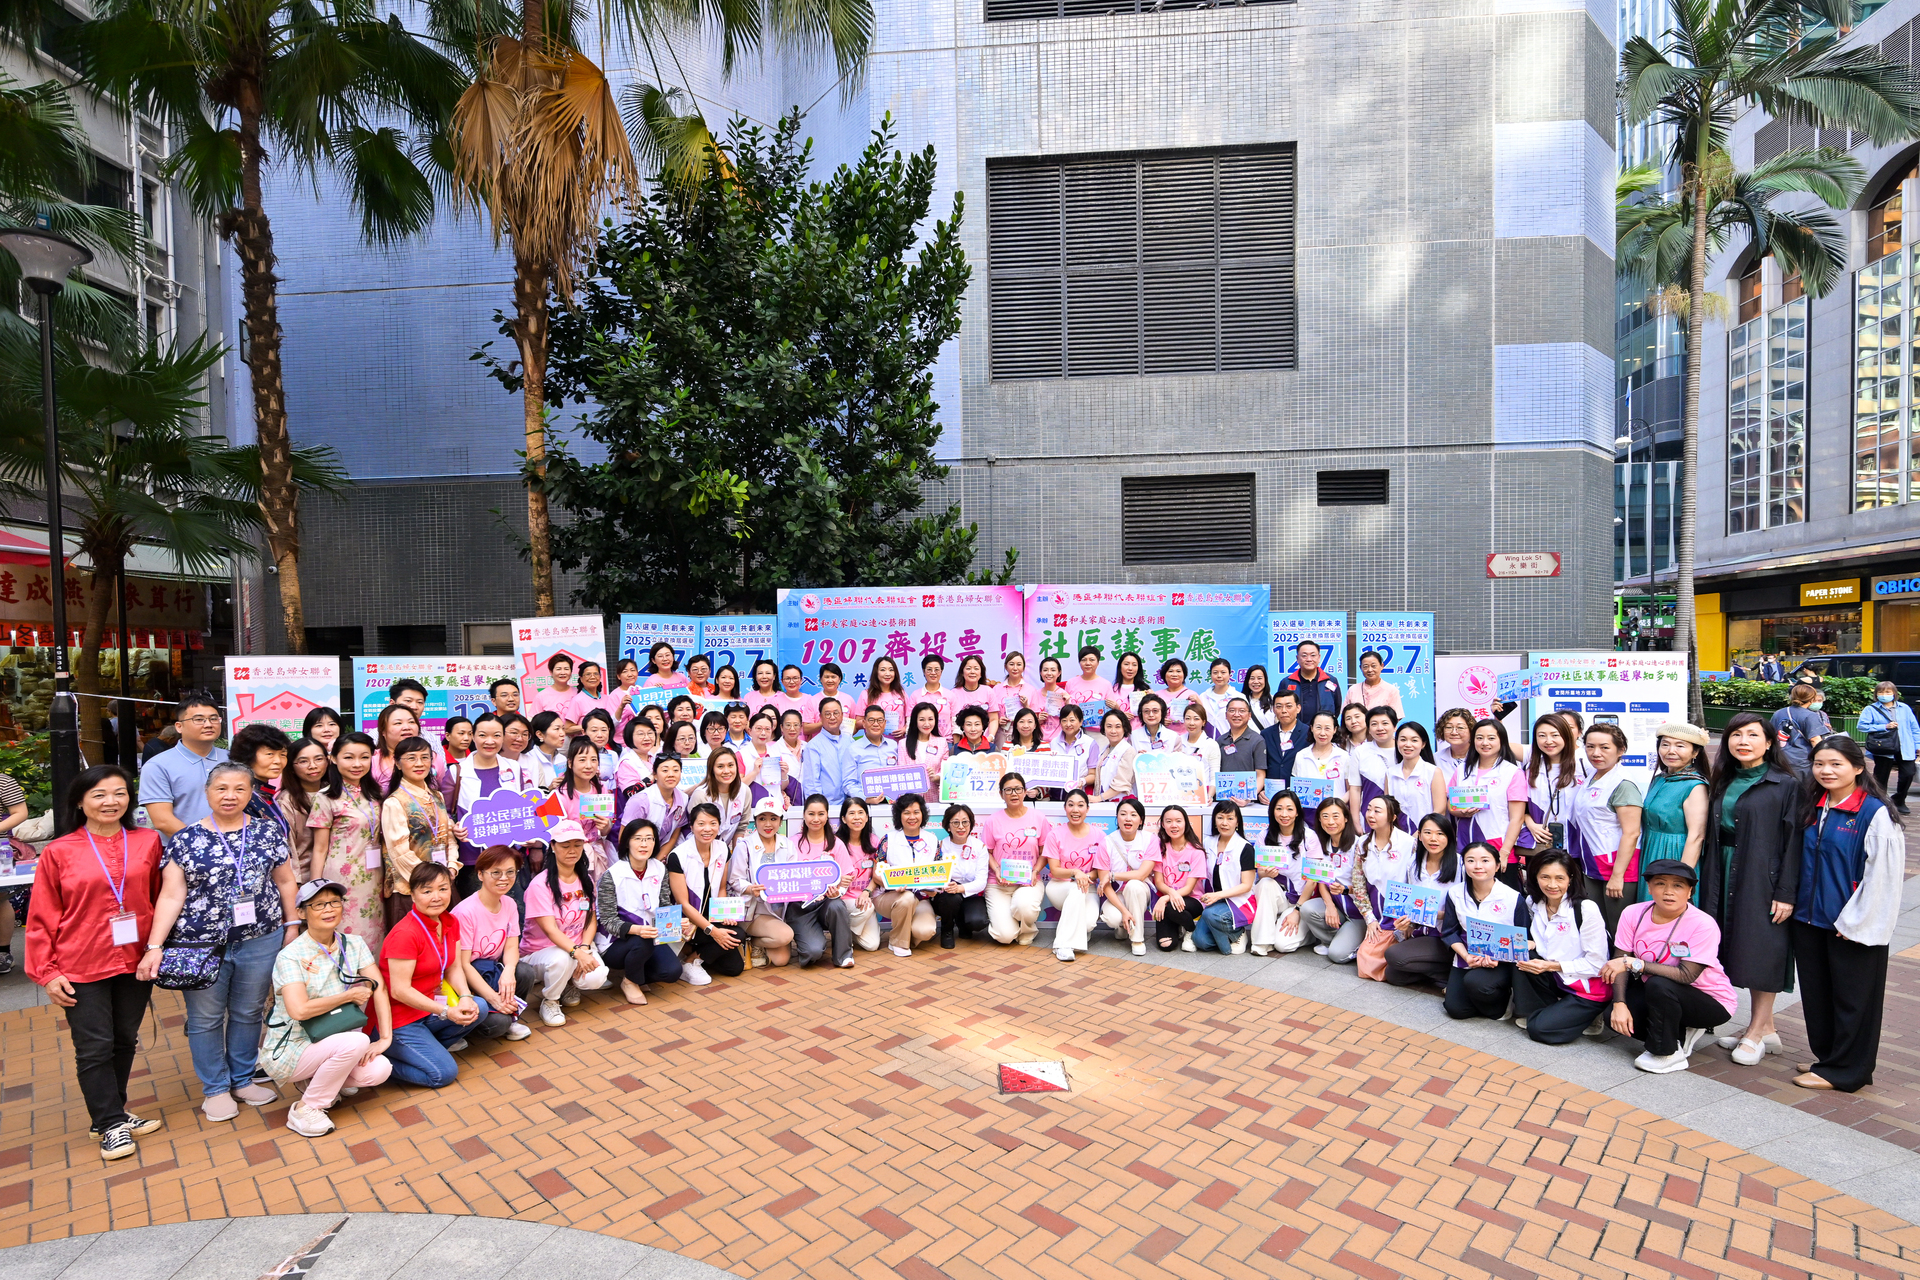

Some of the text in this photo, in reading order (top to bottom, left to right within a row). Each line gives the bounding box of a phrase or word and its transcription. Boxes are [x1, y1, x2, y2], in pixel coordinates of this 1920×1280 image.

[0, 571, 195, 613] 達成燕參茸行
[1806, 589, 1828, 598] PAPER
[1830, 586, 1853, 595] STONE
[663, 624, 695, 632] 共創未來
[1273, 620, 1304, 628] 投入選舉
[534, 625, 597, 636] 香港島婦女聯會
[252, 667, 332, 676] 香港島婦女聯會
[638, 690, 673, 702] 12月7日
[1013, 758, 1040, 767] 齊投票
[1042, 760, 1069, 769] 創未來
[1014, 766, 1068, 778] 共建美好家園
[472, 806, 534, 825] 盡公民責任
[474, 818, 535, 838] 投神聖一票
[778, 880, 822, 893] 投出一票
